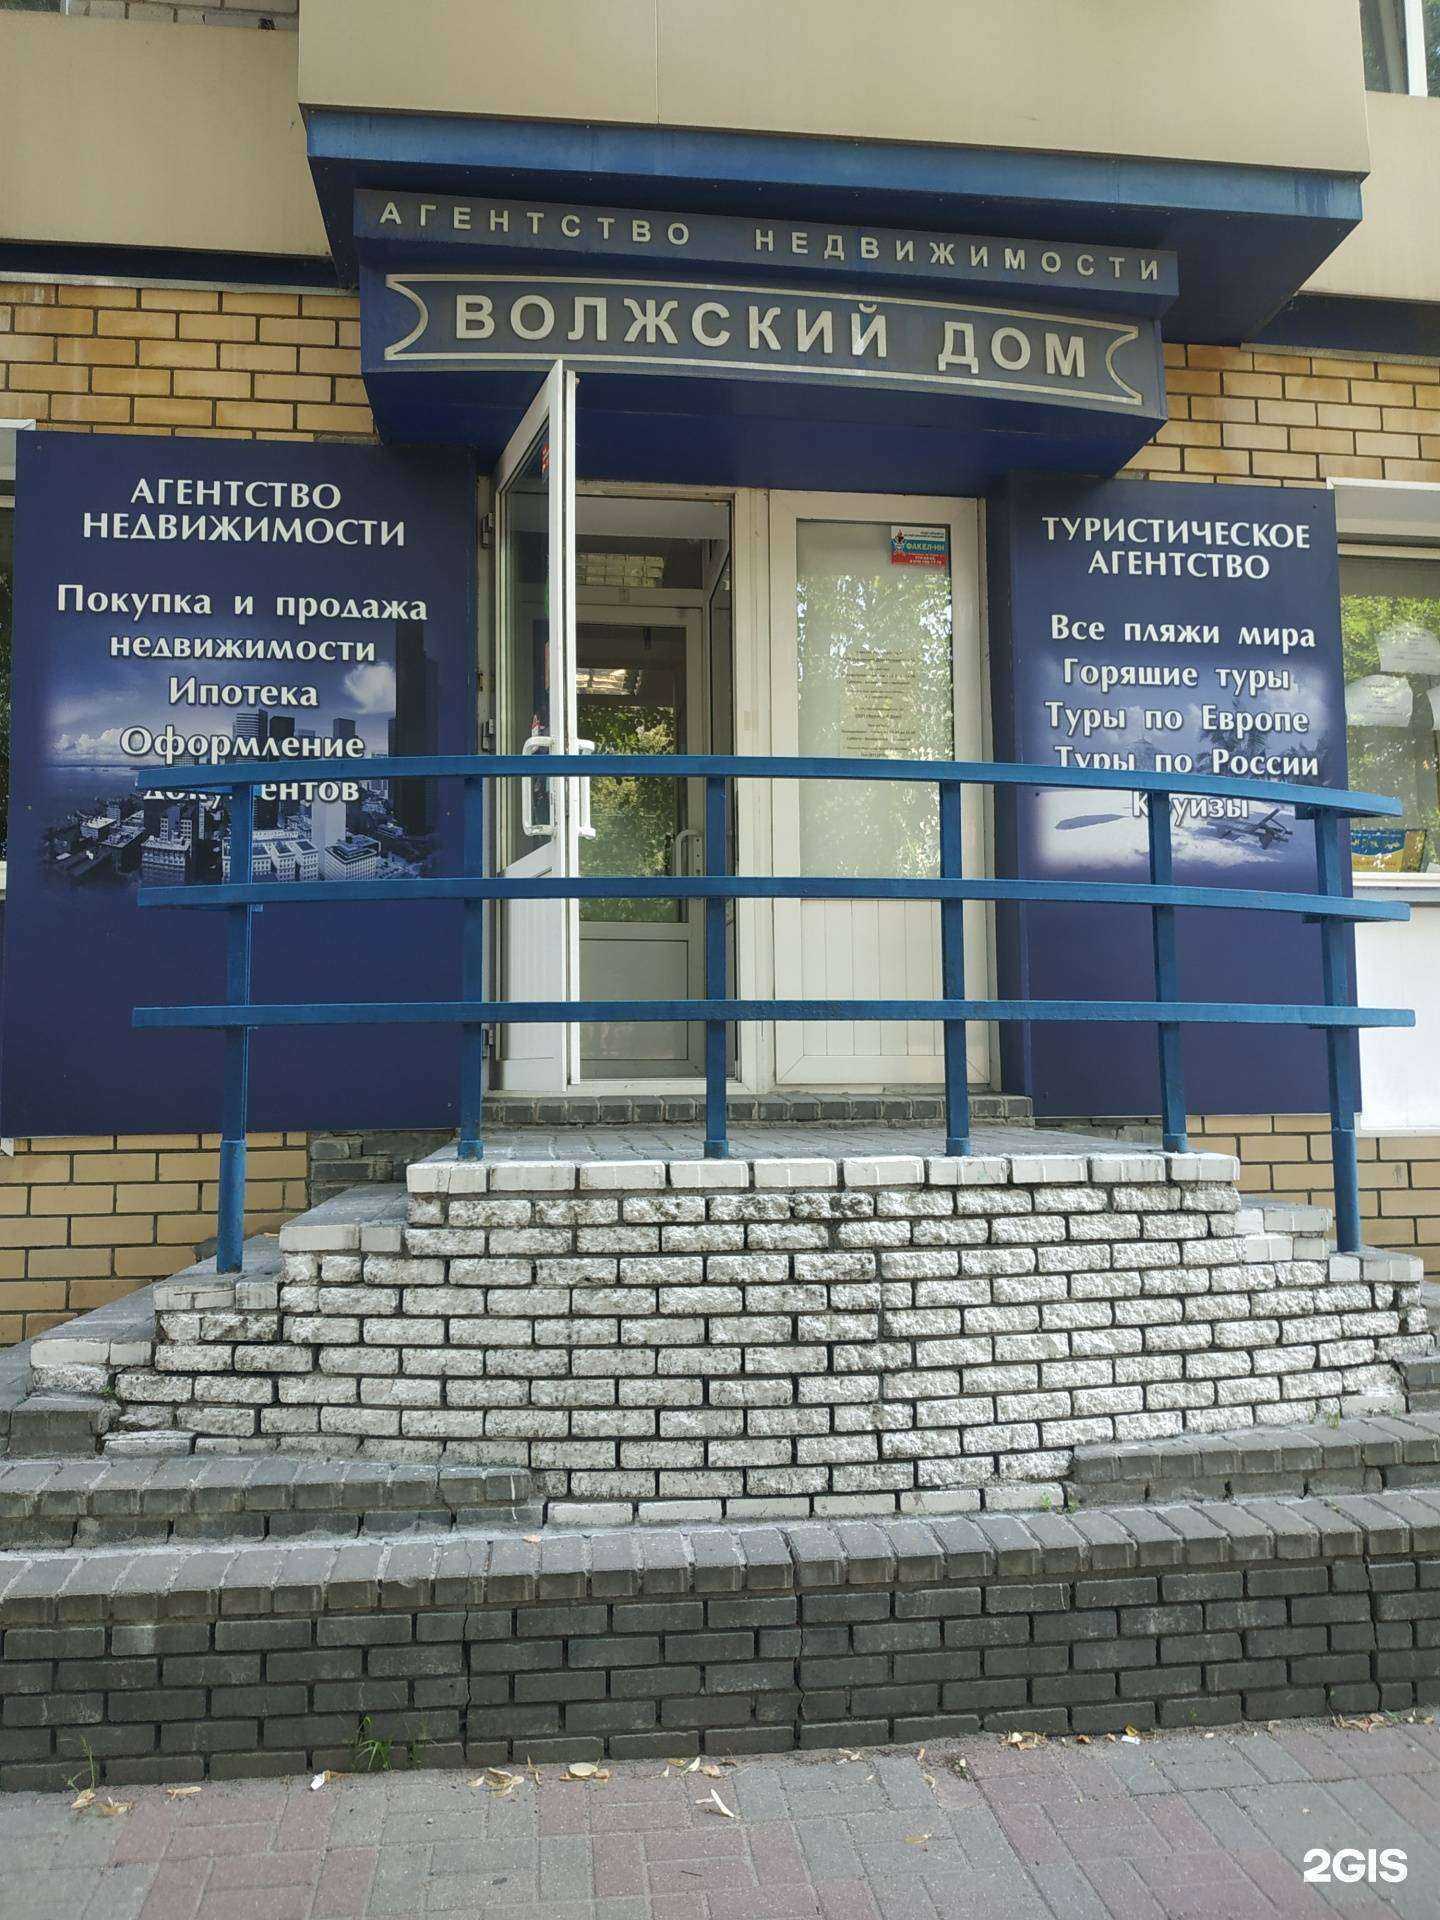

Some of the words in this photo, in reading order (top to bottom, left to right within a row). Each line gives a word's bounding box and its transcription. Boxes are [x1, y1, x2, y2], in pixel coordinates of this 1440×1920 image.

[379, 201, 690, 246] АГЕНТСТВО
[755, 229, 1159, 280] НЕДВИЖИМОСТИ
[455, 293, 888, 359] ВОЛЖСКИЙ
[937, 320, 1087, 379] ДОМ
[130, 477, 342, 510] АГЕНТСТВО
[82, 511, 406, 547] НЕДВИЖИМОСТИ
[1041, 516, 1311, 549] ТУРИСТИЧЕСКОЕ
[1088, 551, 1270, 580] АГЕНТСТВО
[57, 584, 213, 622] Покупка
[234, 596, 254, 615] и
[276, 595, 428, 625] продажа
[110, 636, 376, 661] недвижимости
[1050, 614, 1106, 641] Все
[1124, 622, 1220, 645] пляжи
[1238, 625, 1316, 655] мира
[168, 676, 319, 707] Ипотека
[1215, 667, 1291, 697] туры
[1045, 701, 1126, 737] Туры
[1144, 709, 1183, 731] по
[1202, 704, 1310, 738] Европе
[119, 724, 365, 765] Оформление
[1055, 745, 1136, 771] Туры
[1155, 753, 1193, 774] по
[1213, 749, 1319, 777] России
[143, 779, 361, 810] ентов
[1132, 789, 1249, 826] Куизы
